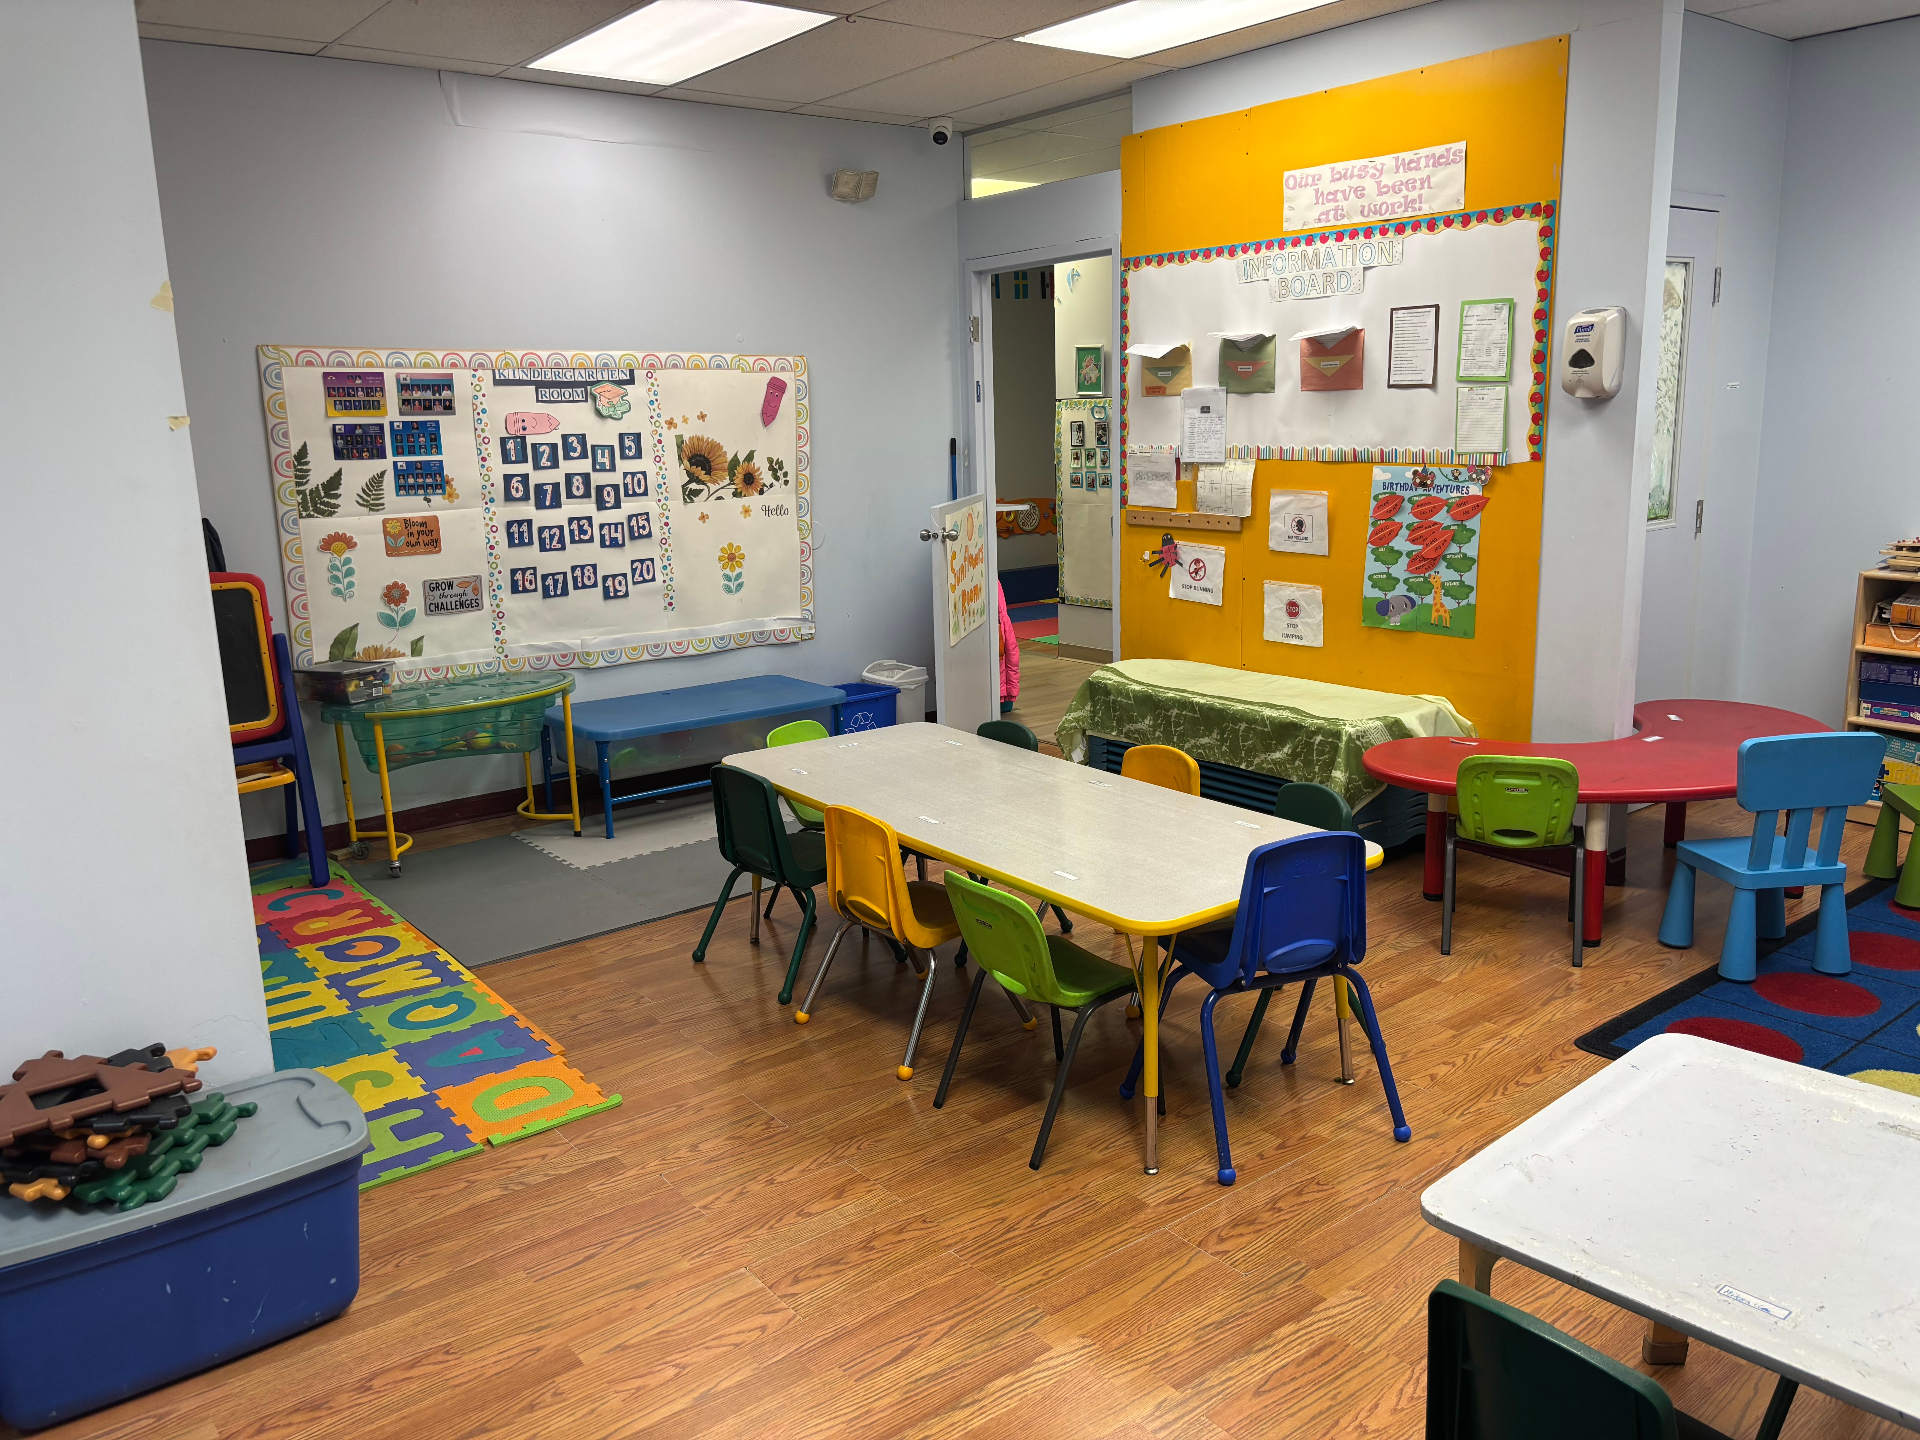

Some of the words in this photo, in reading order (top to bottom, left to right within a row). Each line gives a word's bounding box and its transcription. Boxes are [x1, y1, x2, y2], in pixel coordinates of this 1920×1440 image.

[1284, 173, 1322, 191] Our
[1329, 162, 1385, 183] busy
[1394, 147, 1464, 175] hands
[1313, 183, 1366, 206] have
[1375, 174, 1433, 197] been
[1317, 205, 1346, 224] at
[1360, 193, 1424, 218] work!
[1242, 240, 1394, 280] INFORMATION
[1278, 270, 1352, 299] BOARD
[497, 368, 629, 380] KINDERGARTEN
[539, 388, 585, 400] ROOM
[506, 439, 516, 461] 1
[539, 445, 552, 467] 2
[568, 436, 582, 458] 3
[597, 449, 611, 470] 4
[624, 435, 636, 457] 5
[510, 476, 524, 498] 6
[543, 484, 553, 506] 7
[571, 475, 585, 496] 8
[603, 486, 615, 507] 9
[624, 473, 646, 495] 10
[760, 503, 789, 518] Hello
[403, 518, 428, 530] Bloom
[509, 522, 529, 544] 11
[541, 527, 562, 549] 12
[569, 519, 592, 541] 13
[600, 524, 623, 546] 14
[629, 514, 650, 537] 15
[407, 529, 415, 538] in
[416, 529, 435, 540] your
[405, 540, 421, 548] own
[423, 537, 439, 549] way
[513, 569, 536, 591] 16
[545, 573, 564, 596] 17
[573, 565, 596, 587] 18
[605, 575, 627, 597] 19
[632, 560, 654, 582] 20
[429, 580, 454, 593] GROW
[438, 589, 469, 600] through
[428, 598, 480, 613] CHALLENGES
[1286, 605, 1299, 613] STOP
